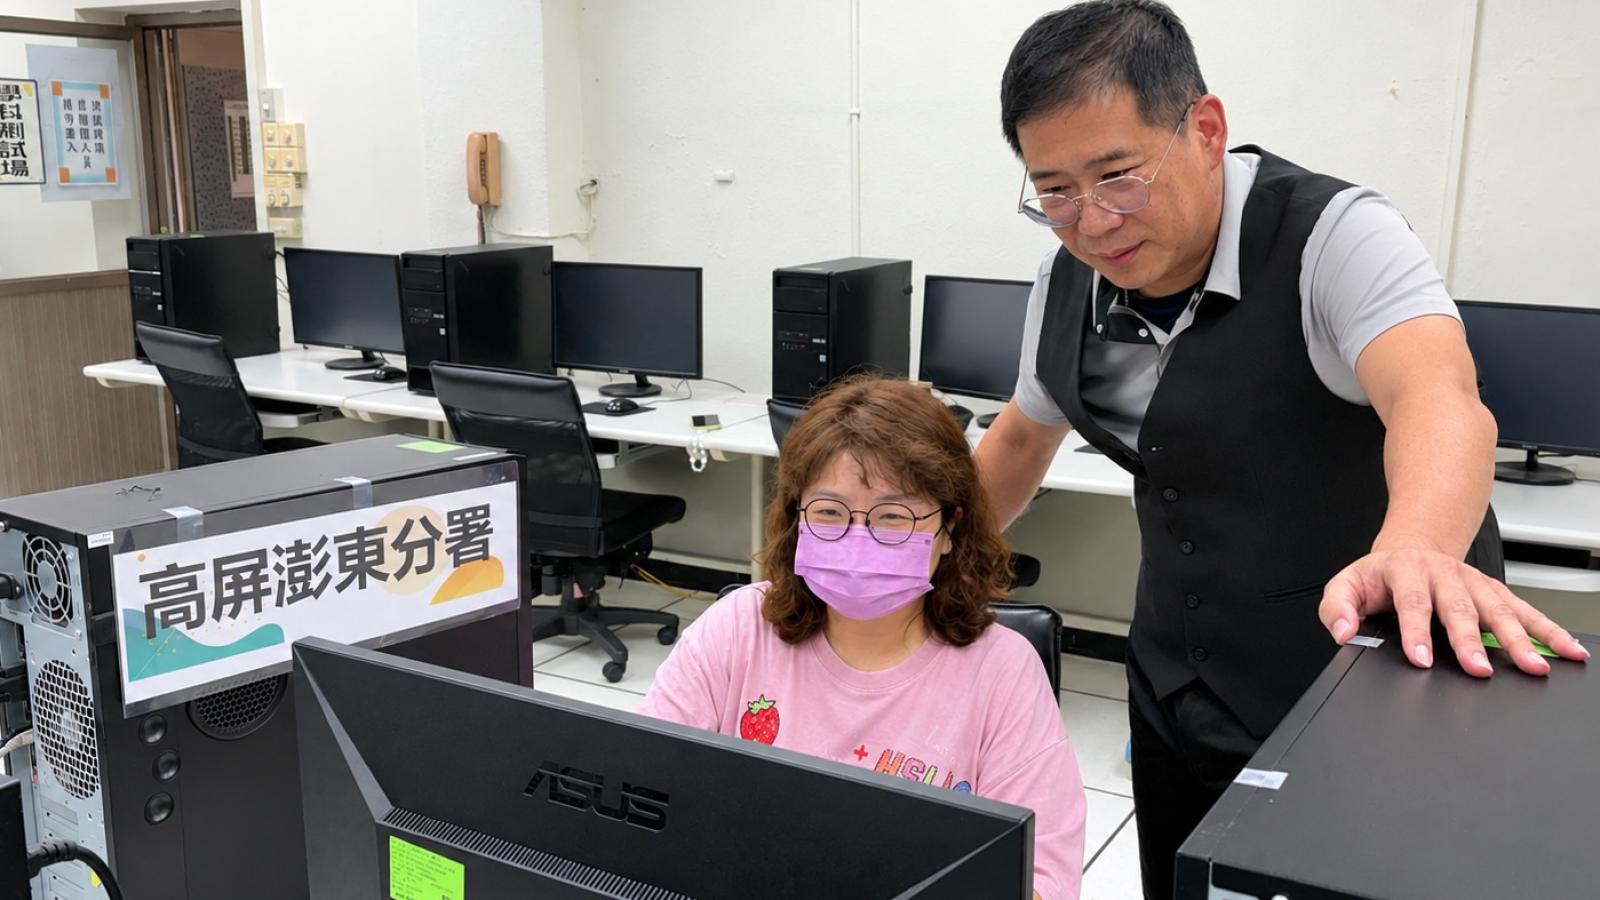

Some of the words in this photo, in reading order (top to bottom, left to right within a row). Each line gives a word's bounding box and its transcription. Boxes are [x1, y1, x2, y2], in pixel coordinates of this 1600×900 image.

[138, 503, 495, 640] 高屏澎東分署
[521, 760, 670, 833] ASUS
